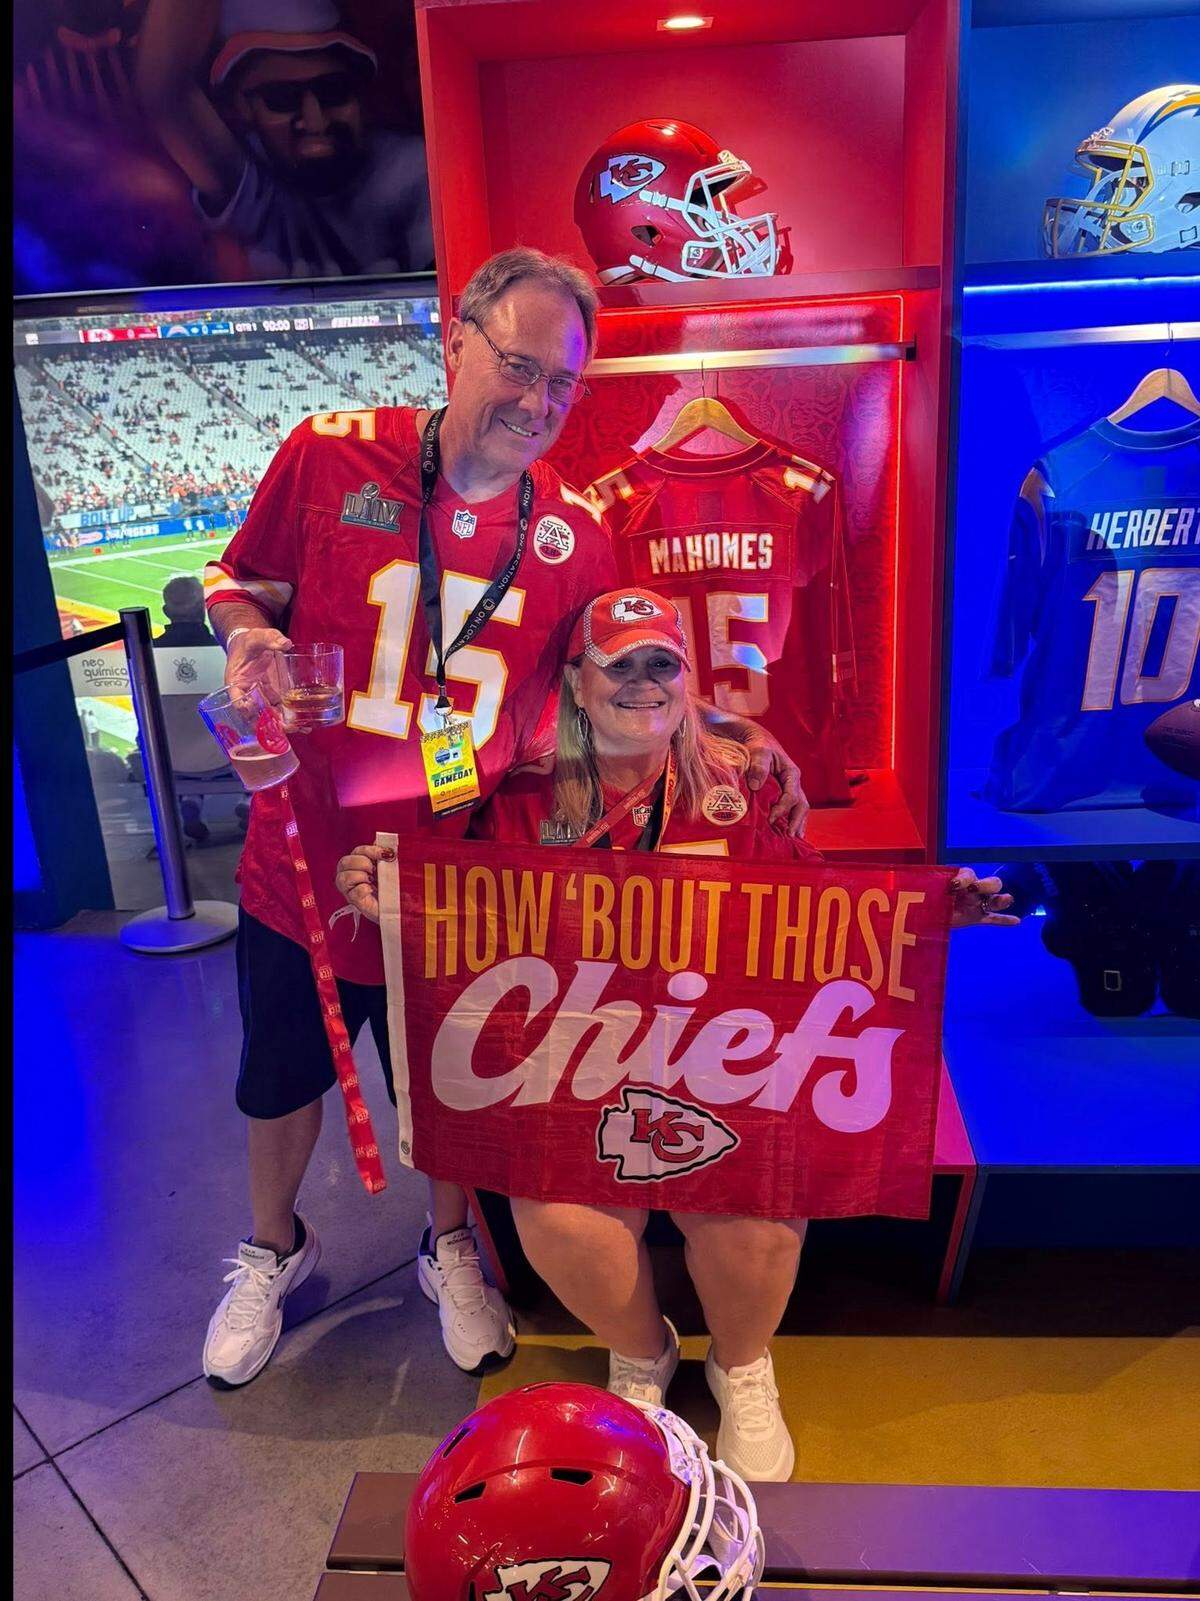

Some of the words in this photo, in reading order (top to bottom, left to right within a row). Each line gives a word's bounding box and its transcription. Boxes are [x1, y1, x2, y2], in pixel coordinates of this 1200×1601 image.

[610, 158, 654, 187] KC
[81, 507, 111, 527] BOLT
[118, 501, 135, 522] UP
[456, 520, 473, 535] NFL
[500, 549, 522, 590] LOCATION
[649, 532, 773, 575] MAHOMES
[346, 559, 526, 752] 15
[1081, 567, 1200, 711] 10
[82, 659, 105, 667] neo
[434, 767, 474, 788] GAMEDAY
[423, 863, 554, 979] HOW
[741, 882, 926, 1002] THOSE
[430, 956, 906, 1134] Chiefs
[631, 1109, 705, 1162] KC
